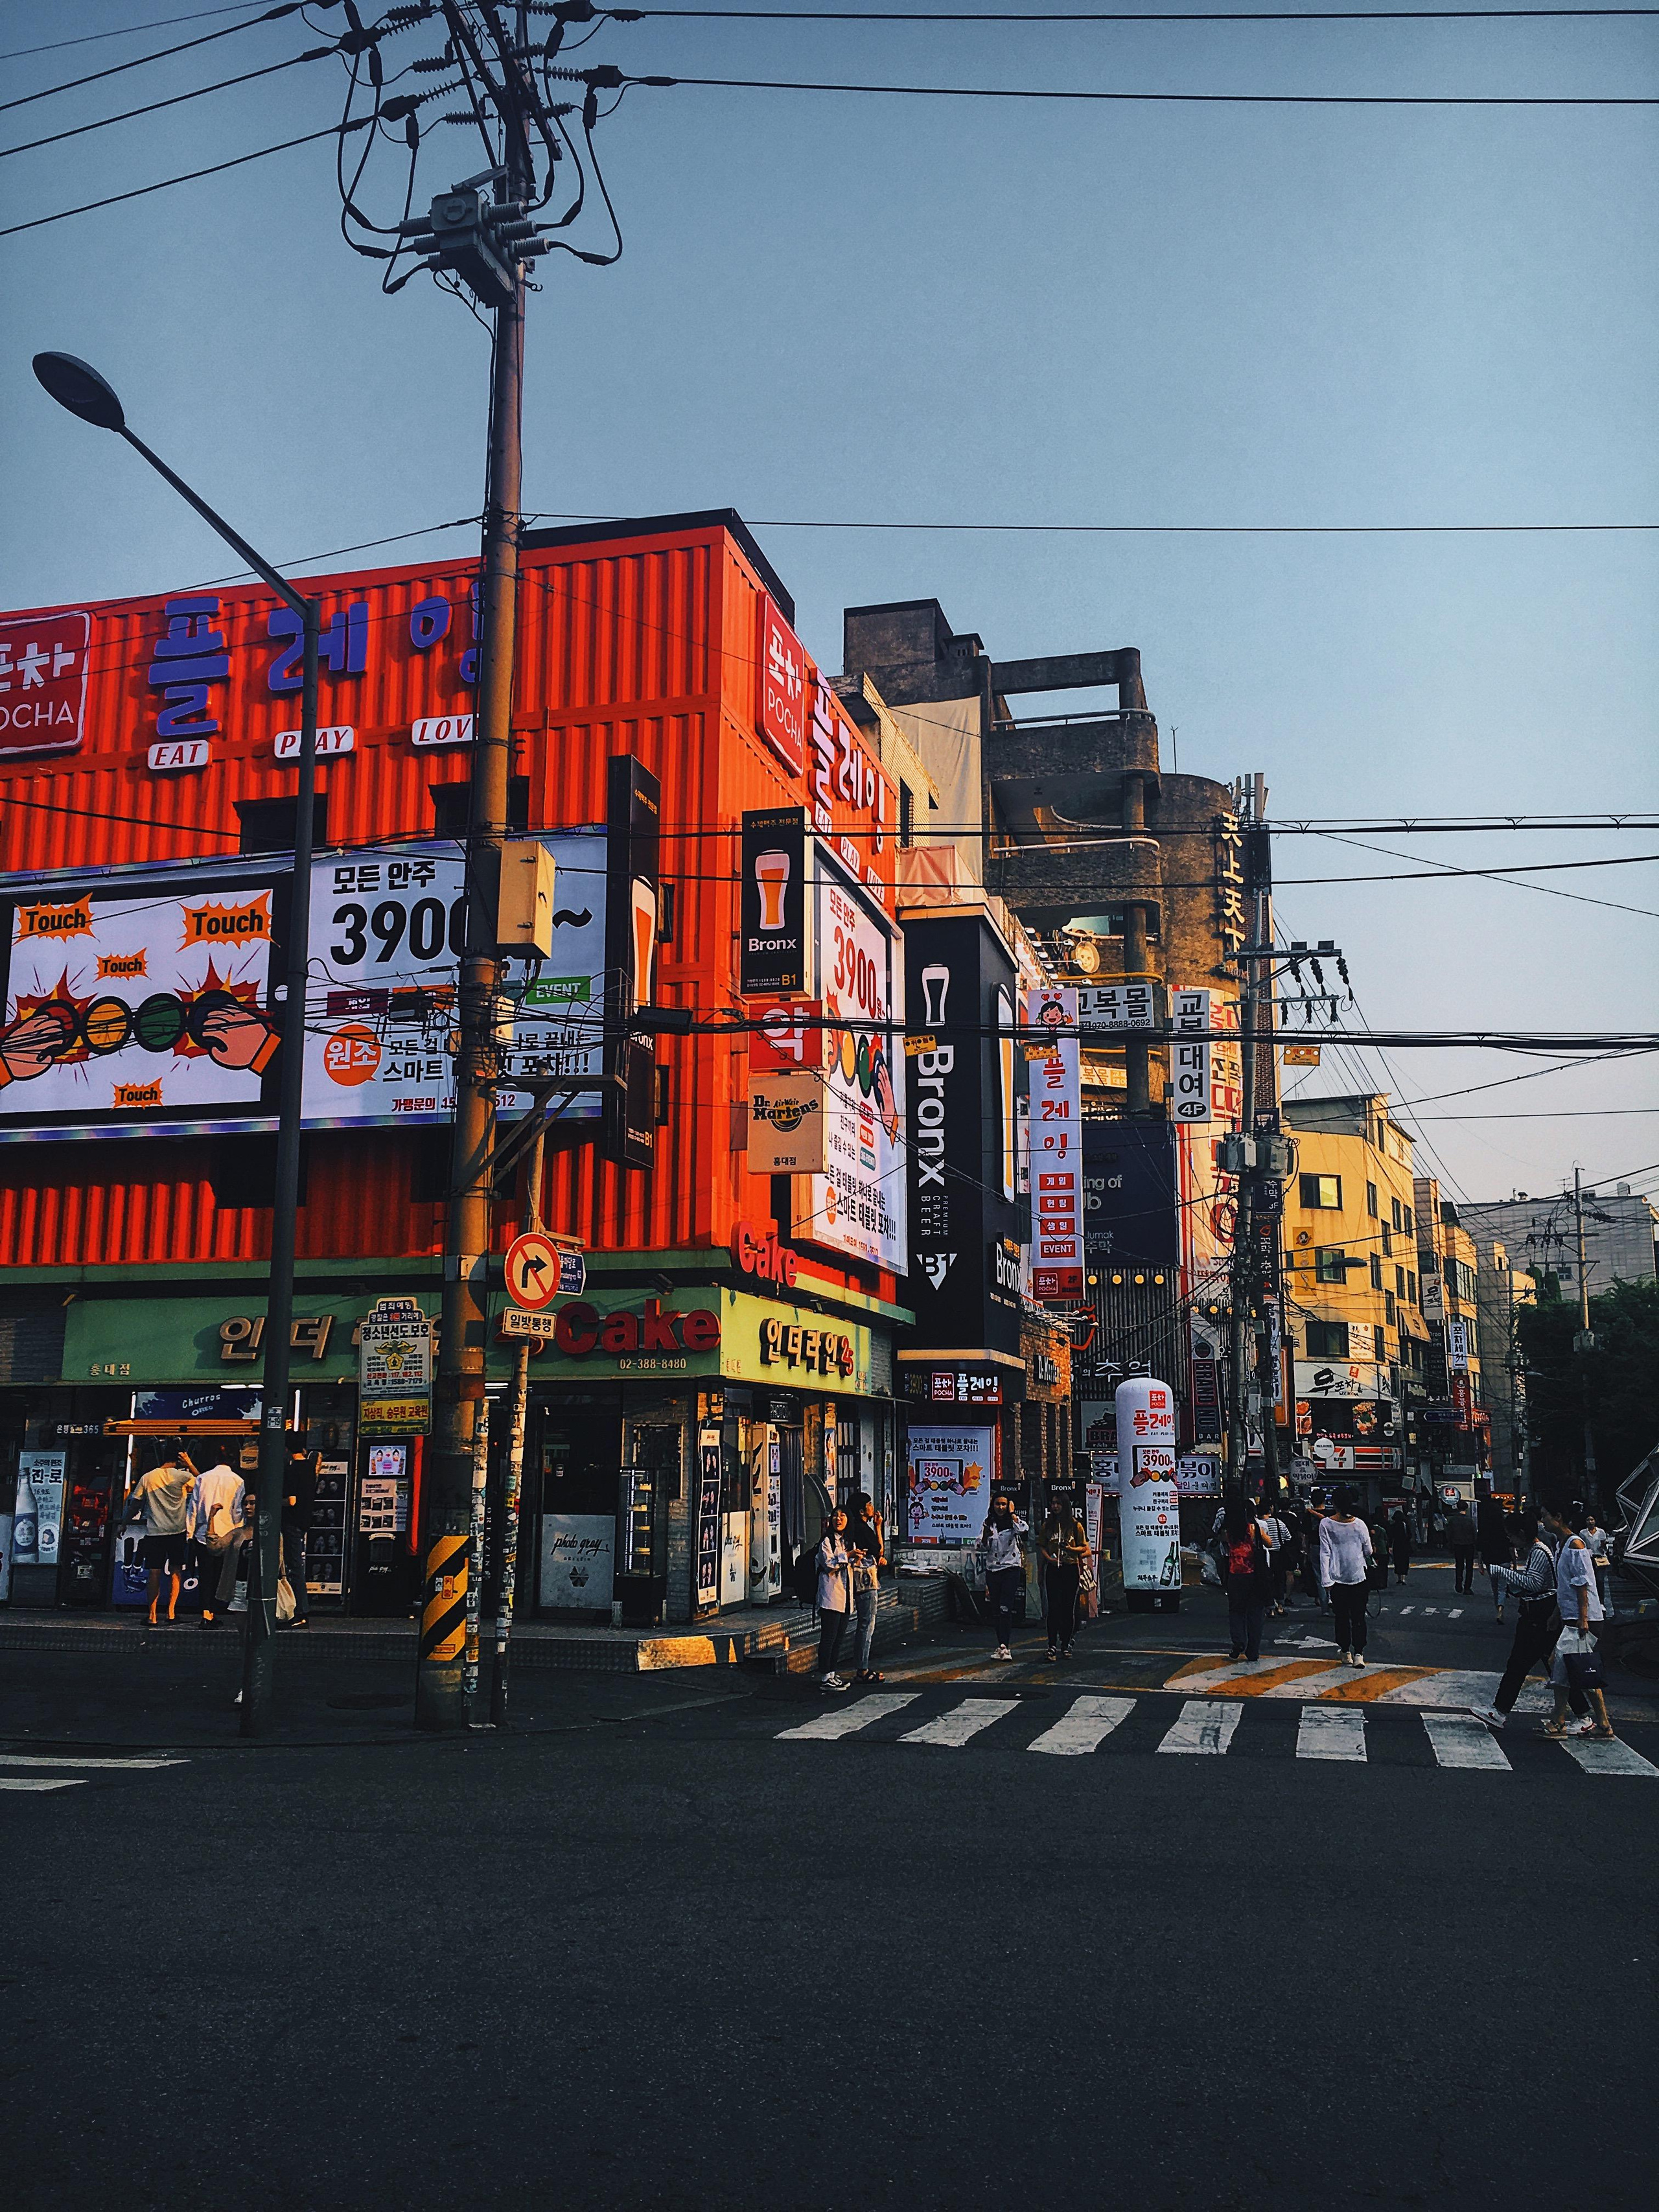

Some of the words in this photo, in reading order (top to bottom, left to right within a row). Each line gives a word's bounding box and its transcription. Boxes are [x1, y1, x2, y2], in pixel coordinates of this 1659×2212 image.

[769, 623, 801, 701] 포차
[0, 700, 74, 731] CHA
[769, 690, 802, 752] POCHA
[419, 716, 471, 743] LOV
[155, 743, 200, 766] EAT
[750, 819, 776, 829] 수제맥주
[778, 817, 798, 827] 전문점
[817, 808, 831, 838] EAT
[842, 839, 859, 870] PLAY
[332, 863, 381, 894] 모든
[388, 860, 435, 891] 안주
[869, 870, 883, 902] LOVE
[26, 908, 86, 931] Touch
[830, 888, 842, 921] 모든
[843, 902, 855, 933] 안주
[192, 909, 263, 936] Touch
[748, 938, 796, 952] Bronx
[102, 958, 143, 973] Touch
[833, 926, 876, 1019] 3900
[782, 973, 796, 986] B1
[536, 983, 581, 999] EVENT
[761, 1007, 811, 1061] 약
[327, 1040, 377, 1070] 원조
[382, 1059, 444, 1084] 스마트
[119, 1087, 158, 1102] Touch
[753, 1095, 771, 1107] Dr.
[391, 1097, 435, 1112] 가맹문의
[753, 1099, 818, 1121] Martens
[1041, 1054, 1070, 1159] 플레잉
[1180, 1104, 1203, 1115] 4F
[918, 1045, 955, 1188] Bronx
[645, 1131, 653, 1148] B1
[842, 1140, 846, 1155] 수
[773, 1156, 796, 1166] 홍대점
[836, 1167, 841, 1189] 걸
[1046, 1176, 1067, 1186] 게임
[1108, 1174, 1122, 1189] of
[837, 1192, 857, 1222] 스마트
[921, 1195, 931, 1237] BEER
[1047, 1221, 1068, 1231] 생일
[732, 1221, 798, 1288] Cake
[1043, 1244, 1073, 1253] EVENT
[996, 1242, 1022, 1293] Bronx
[1038, 1276, 1056, 1285] 포차
[380, 1301, 412, 1310] 범죄예방
[371, 1313, 388, 1322] 경찰은
[510, 1314, 551, 1333] 일방통행
[556, 1299, 721, 1353] Cake
[89, 1362, 130, 1377] 홍대점
[620, 1358, 687, 1370] 02-388-8480
[1095, 1359, 1151, 1383] 추억
[934, 1377, 952, 1388] 포차
[957, 1373, 998, 1396] 플레잉
[1196, 1362, 1215, 1404] BRAND
[181, 1393, 221, 1409] Churros
[1151, 1393, 1165, 1401] 포차
[191, 1405, 214, 1416] OREO
[386, 1406, 406, 1419] 승무원
[408, 1405, 428, 1418] 교육원
[1090, 1430, 1118, 1442] BRA
[1143, 1454, 1170, 1467] 3900
[923, 1467, 949, 1477] 3900
[1175, 1461, 1216, 1479] 볶이
[551, 1533, 577, 1555] photo
